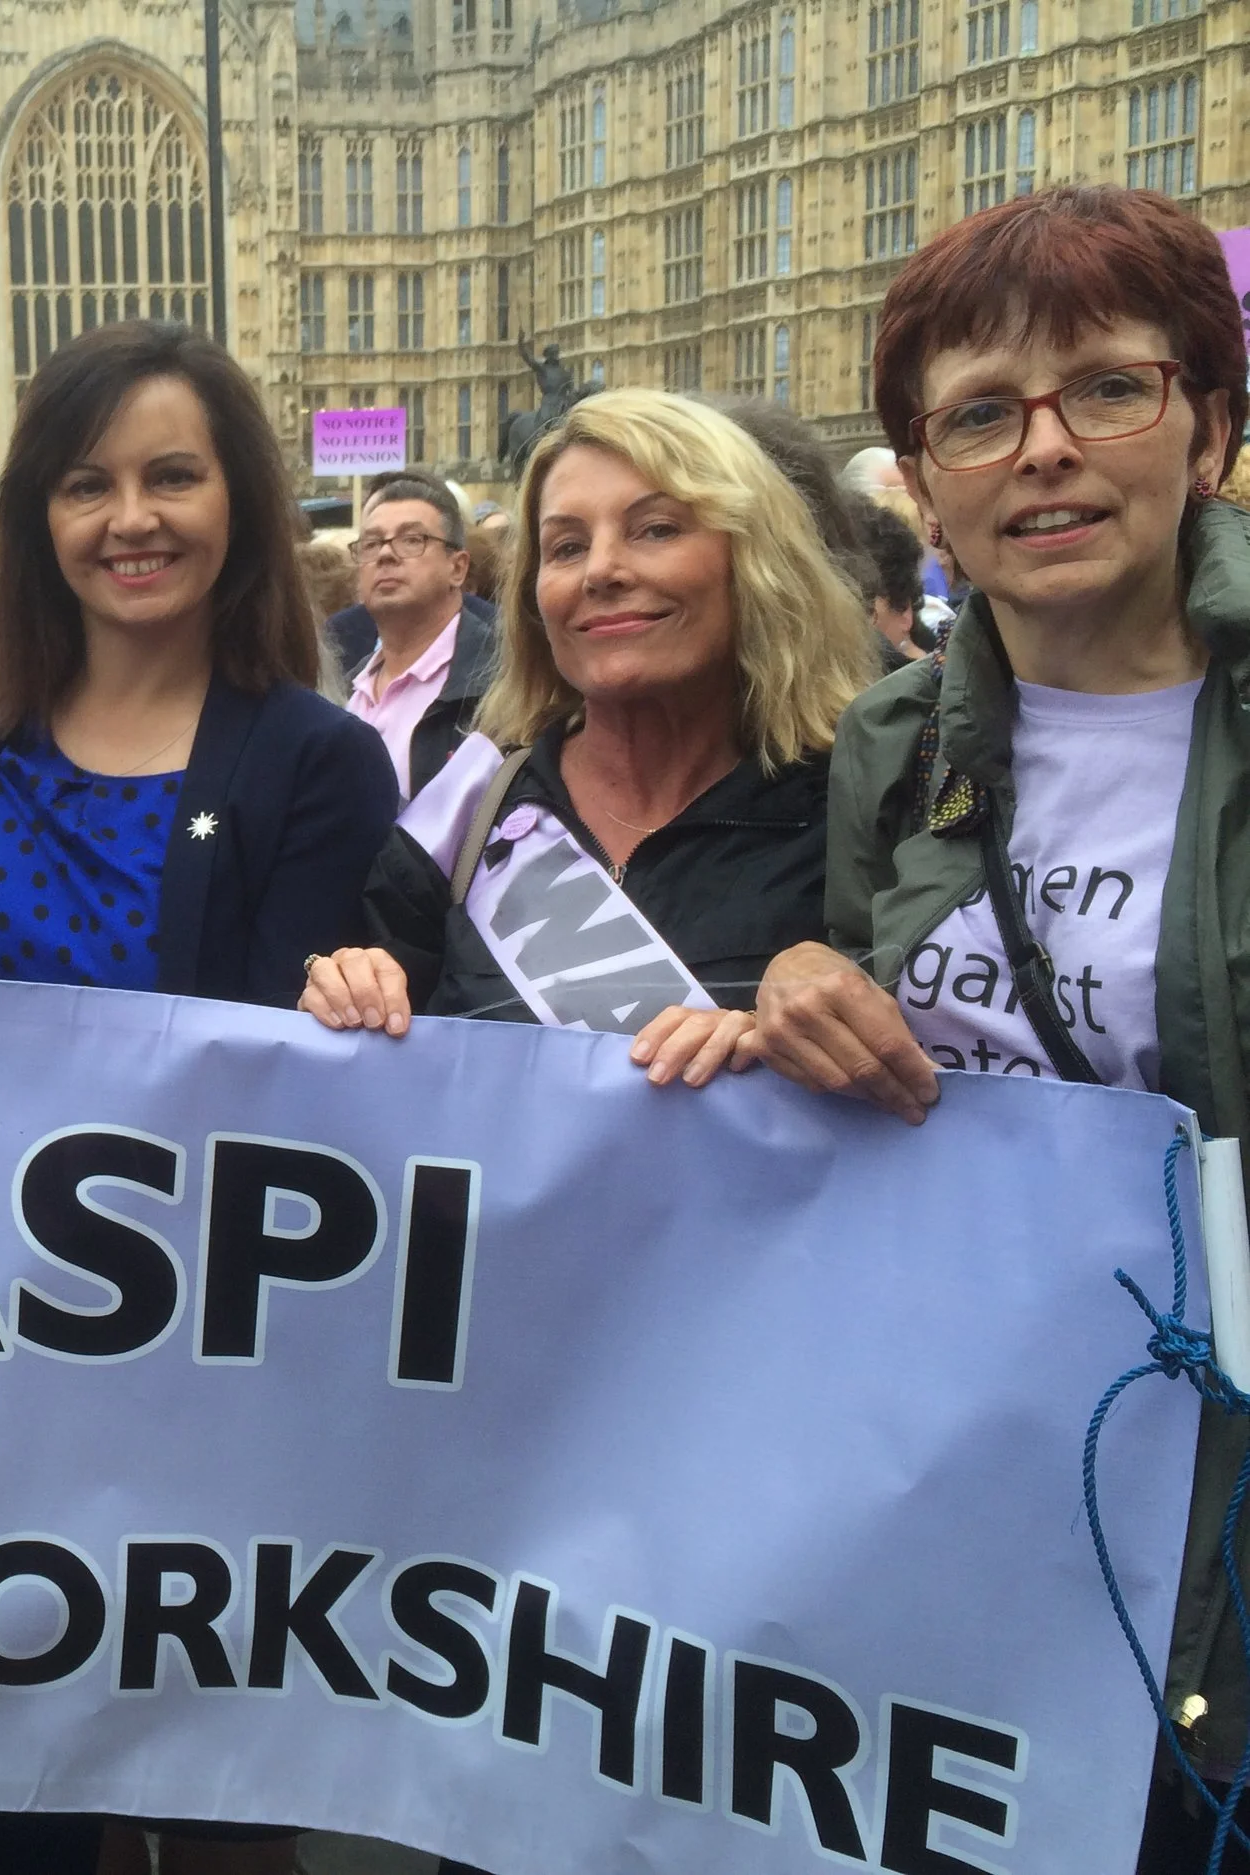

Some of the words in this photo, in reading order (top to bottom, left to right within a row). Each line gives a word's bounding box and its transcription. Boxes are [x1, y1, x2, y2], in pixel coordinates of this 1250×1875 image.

[322, 419, 342, 430] NO
[346, 416, 397, 429] NOTICE
[321, 437, 341, 447] NO
[345, 435, 398, 446] LETTER
[319, 454, 338, 464] NO
[342, 452, 399, 463] PENSION
